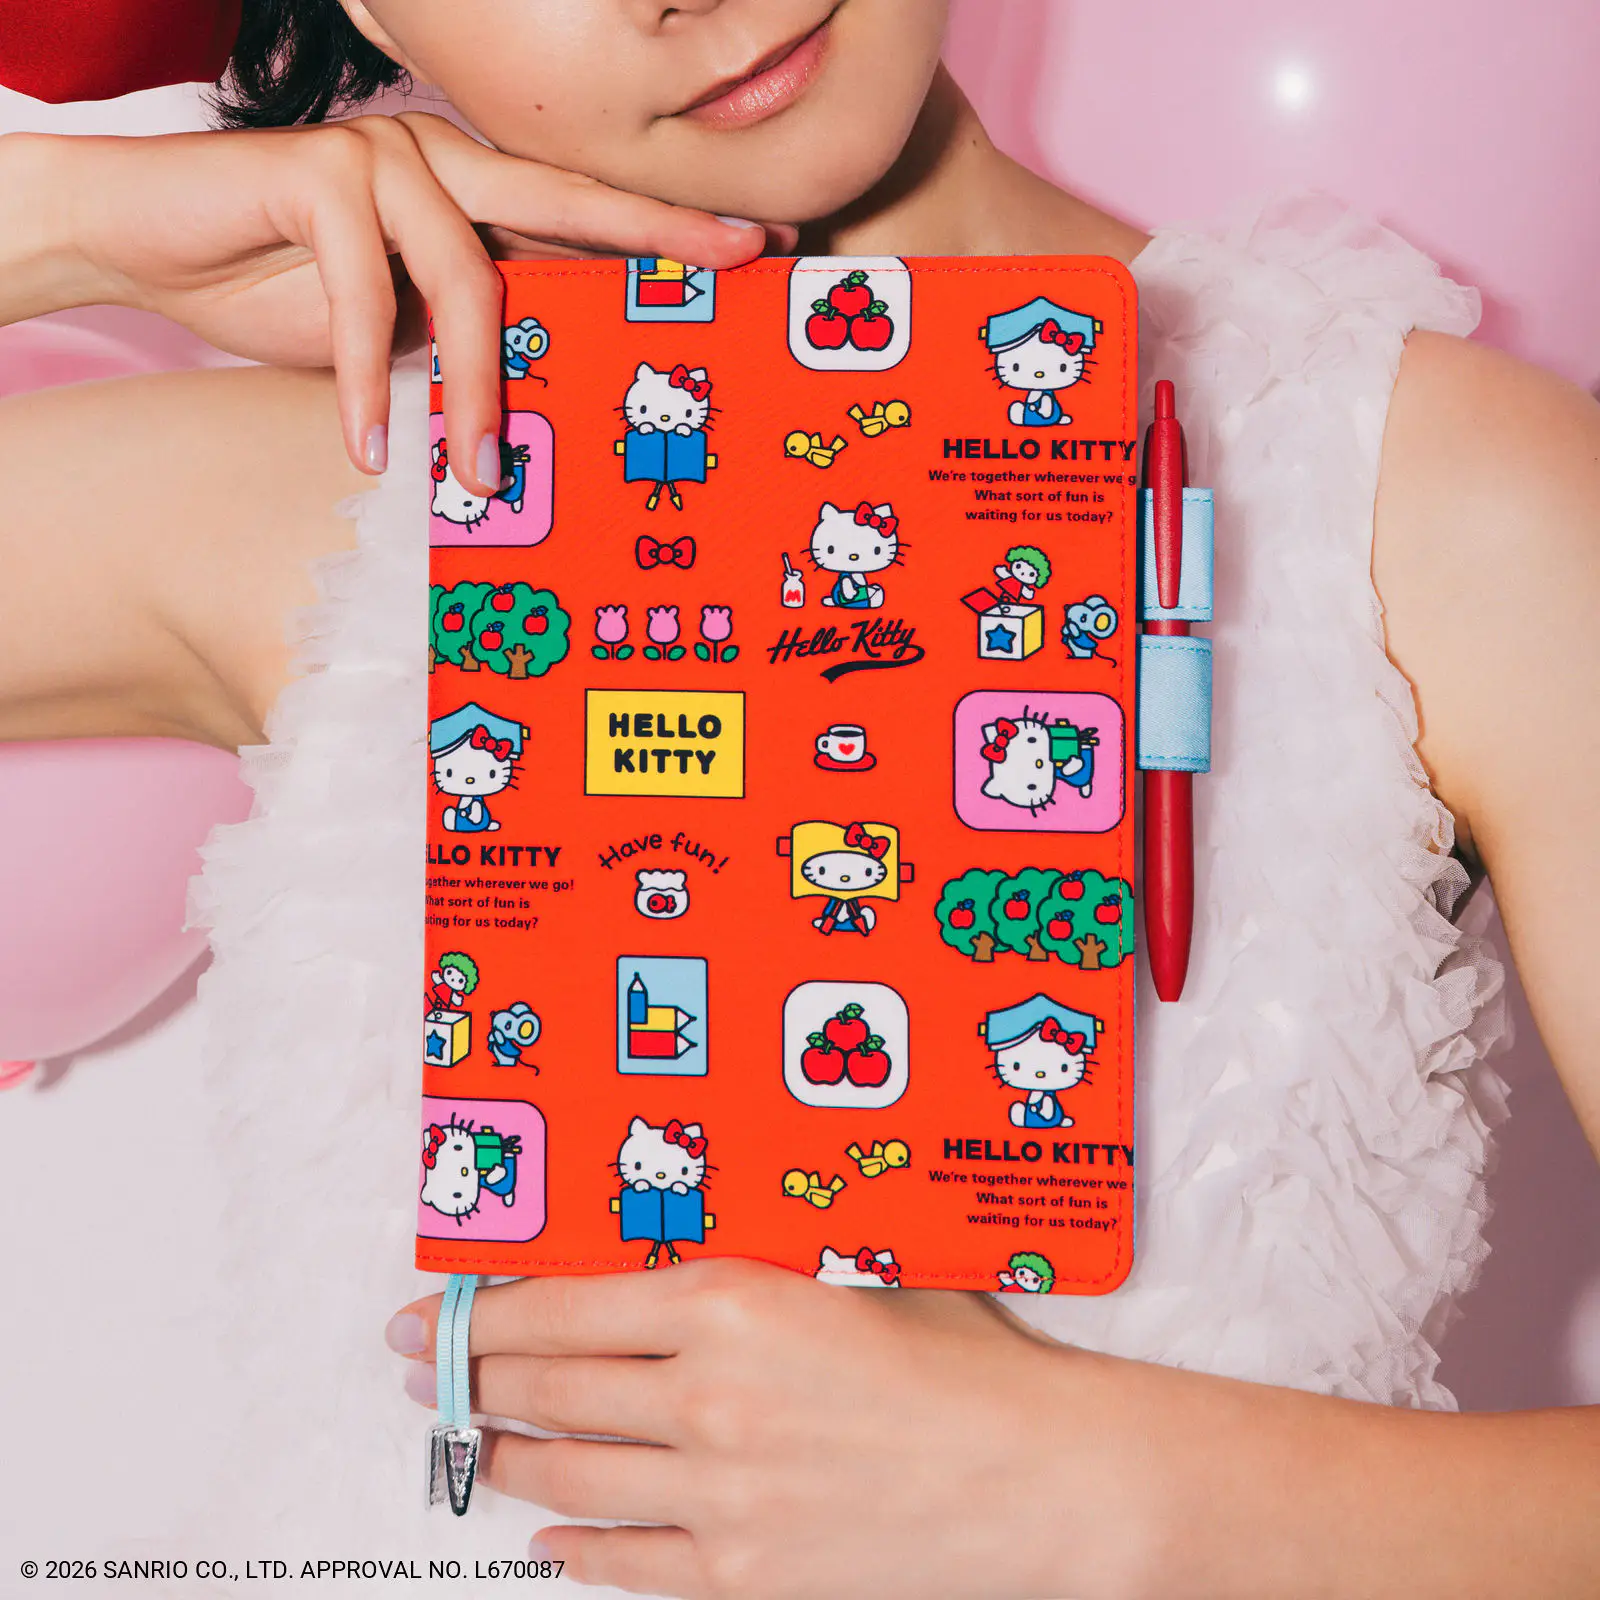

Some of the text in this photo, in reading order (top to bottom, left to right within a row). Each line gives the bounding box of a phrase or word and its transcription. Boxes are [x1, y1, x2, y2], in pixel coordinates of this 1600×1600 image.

[943, 438, 1137, 461] HELLO KITTY
[928, 470, 966, 481] We're
[970, 471, 1030, 484] together
[1034, 471, 1100, 483] wherever
[1103, 474, 1123, 483] we
[974, 490, 1105, 503] What sort of fun is
[965, 509, 1113, 524] waiting for us today?
[767, 617, 925, 665] Hello Kitty
[608, 712, 722, 740] HELLO
[614, 748, 716, 775] KITTY
[426, 844, 562, 867] LLO KITTY
[598, 831, 730, 874] Have fun!
[465, 877, 526, 890] wherever
[529, 880, 548, 890] we
[552, 879, 575, 893] go!
[447, 897, 473, 908] sort
[477, 897, 490, 908] of
[494, 897, 515, 909] fun
[519, 897, 530, 909] is
[453, 914, 471, 927] for
[475, 917, 490, 927] us
[494, 916, 539, 931] today?
[943, 1138, 1043, 1162] HELLO
[928, 1171, 967, 1183] We're
[972, 1173, 1033, 1187] together
[1036, 1175, 1103, 1189] wherever
[1106, 1180, 1127, 1190] we
[976, 1192, 1108, 1209] What sort of fun is
[967, 1214, 1117, 1232] waiting for us today?
